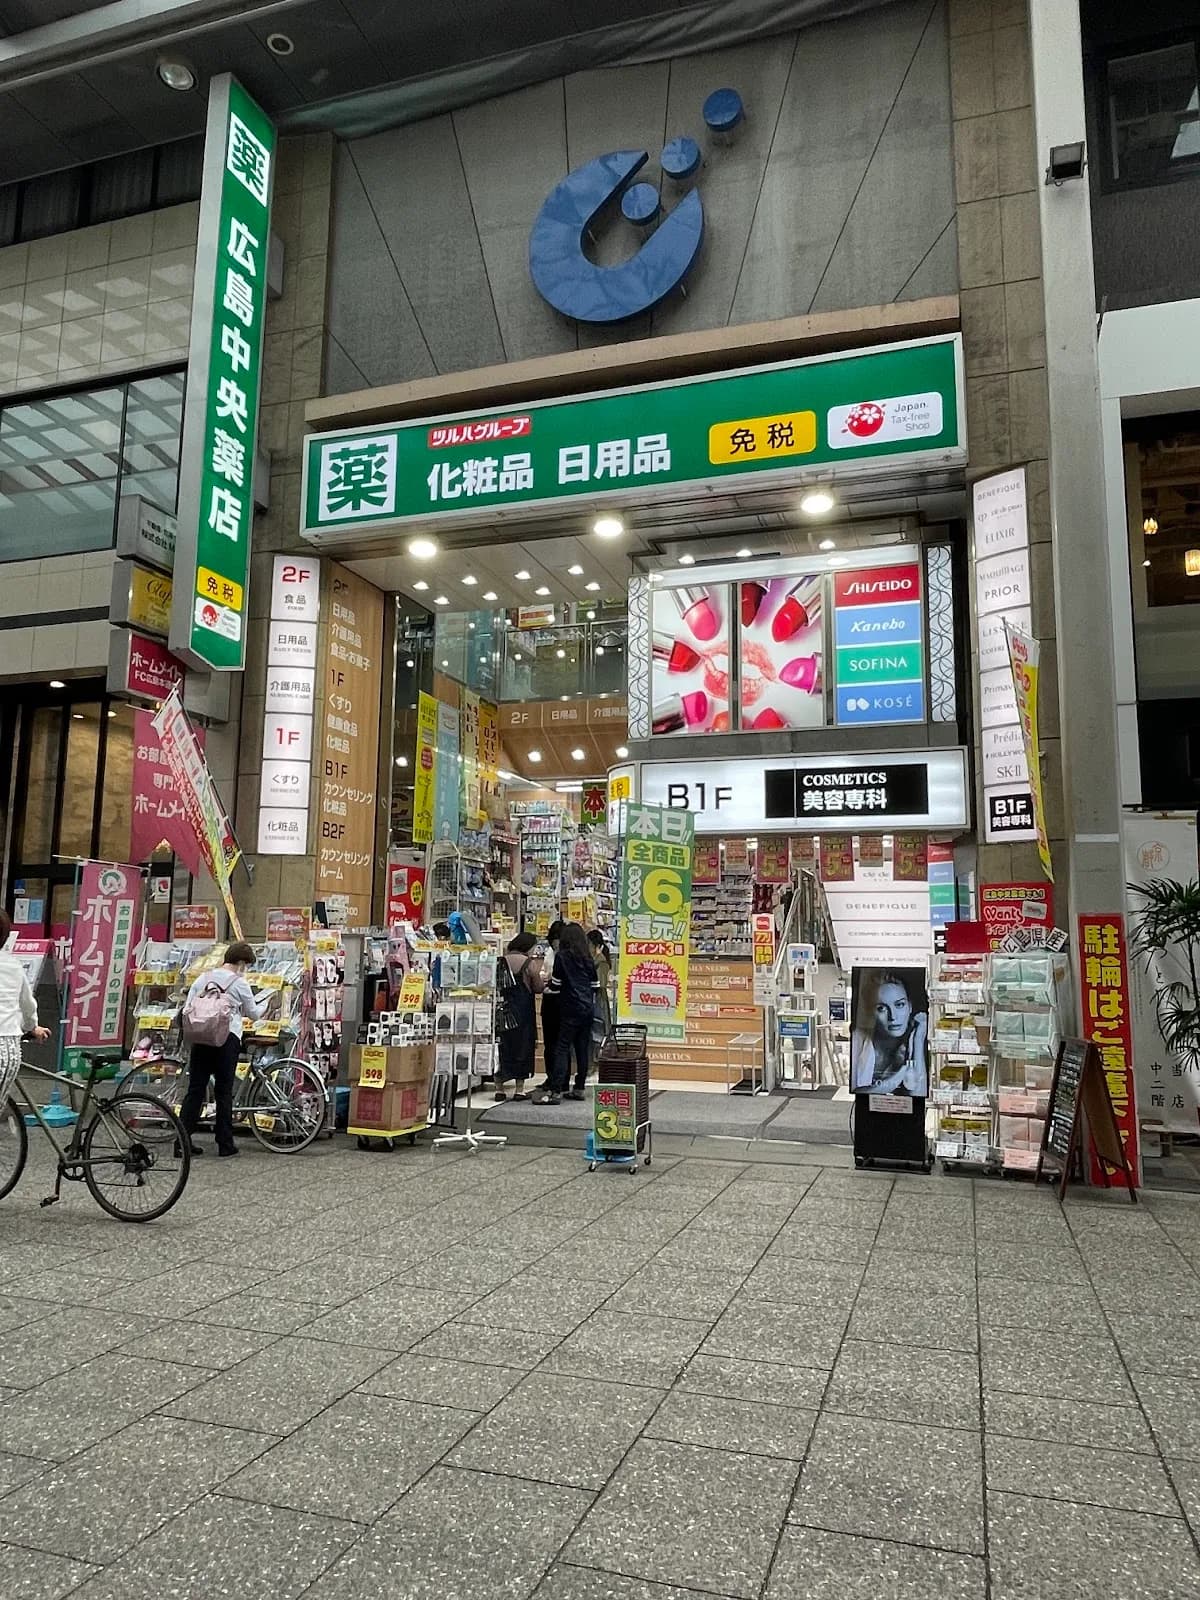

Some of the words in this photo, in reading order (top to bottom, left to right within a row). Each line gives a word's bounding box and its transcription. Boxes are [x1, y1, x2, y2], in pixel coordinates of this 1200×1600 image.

[230, 121, 266, 197] 薬
[208, 216, 259, 543] 広島中央薬店
[891, 411, 930, 424] Tax-free
[431, 416, 531, 447] ツルハグループ
[905, 422, 930, 433] Shop
[730, 420, 795, 455] 免税
[558, 433, 671, 484] 日用品
[326, 443, 390, 513] 薬
[427, 452, 534, 501] 化粧品
[282, 566, 310, 584] 2F
[207, 577, 233, 603] 免税
[843, 579, 912, 596] SHISEIDO
[985, 584, 1021, 601] PRIOR
[284, 594, 306, 605] 食品
[850, 618, 905, 633] Kanebo
[278, 634, 308, 646] 日用品
[850, 656, 908, 671] SOFINA
[270, 680, 311, 693] 介護用品
[331, 669, 345, 687] 1F
[328, 693, 352, 713] くすり
[873, 695, 912, 709] KOSÉ
[511, 711, 529, 725] 2F
[551, 708, 578, 721] 日用品
[275, 727, 301, 746] 1F
[272, 773, 299, 785] くすり
[325, 760, 349, 780] B1F
[803, 772, 887, 787] COSMETICS
[324, 780, 373, 805] カウンセリング
[668, 782, 732, 811] B1F
[803, 788, 888, 811] 美容専科
[994, 799, 1027, 815] B1F
[267, 821, 299, 833] 化粧品
[322, 821, 346, 840] B2F
[992, 815, 1032, 828] 美容専科
[320, 847, 372, 867] カウンセリング
[632, 842, 685, 867] 全商品
[319, 864, 344, 880] ルーム
[985, 906, 1025, 923] Wants
[71, 895, 112, 1044] ホームメイト
[103, 904, 130, 1034] お部屋探しの専門店
[364, 1068, 383, 1079] 598
